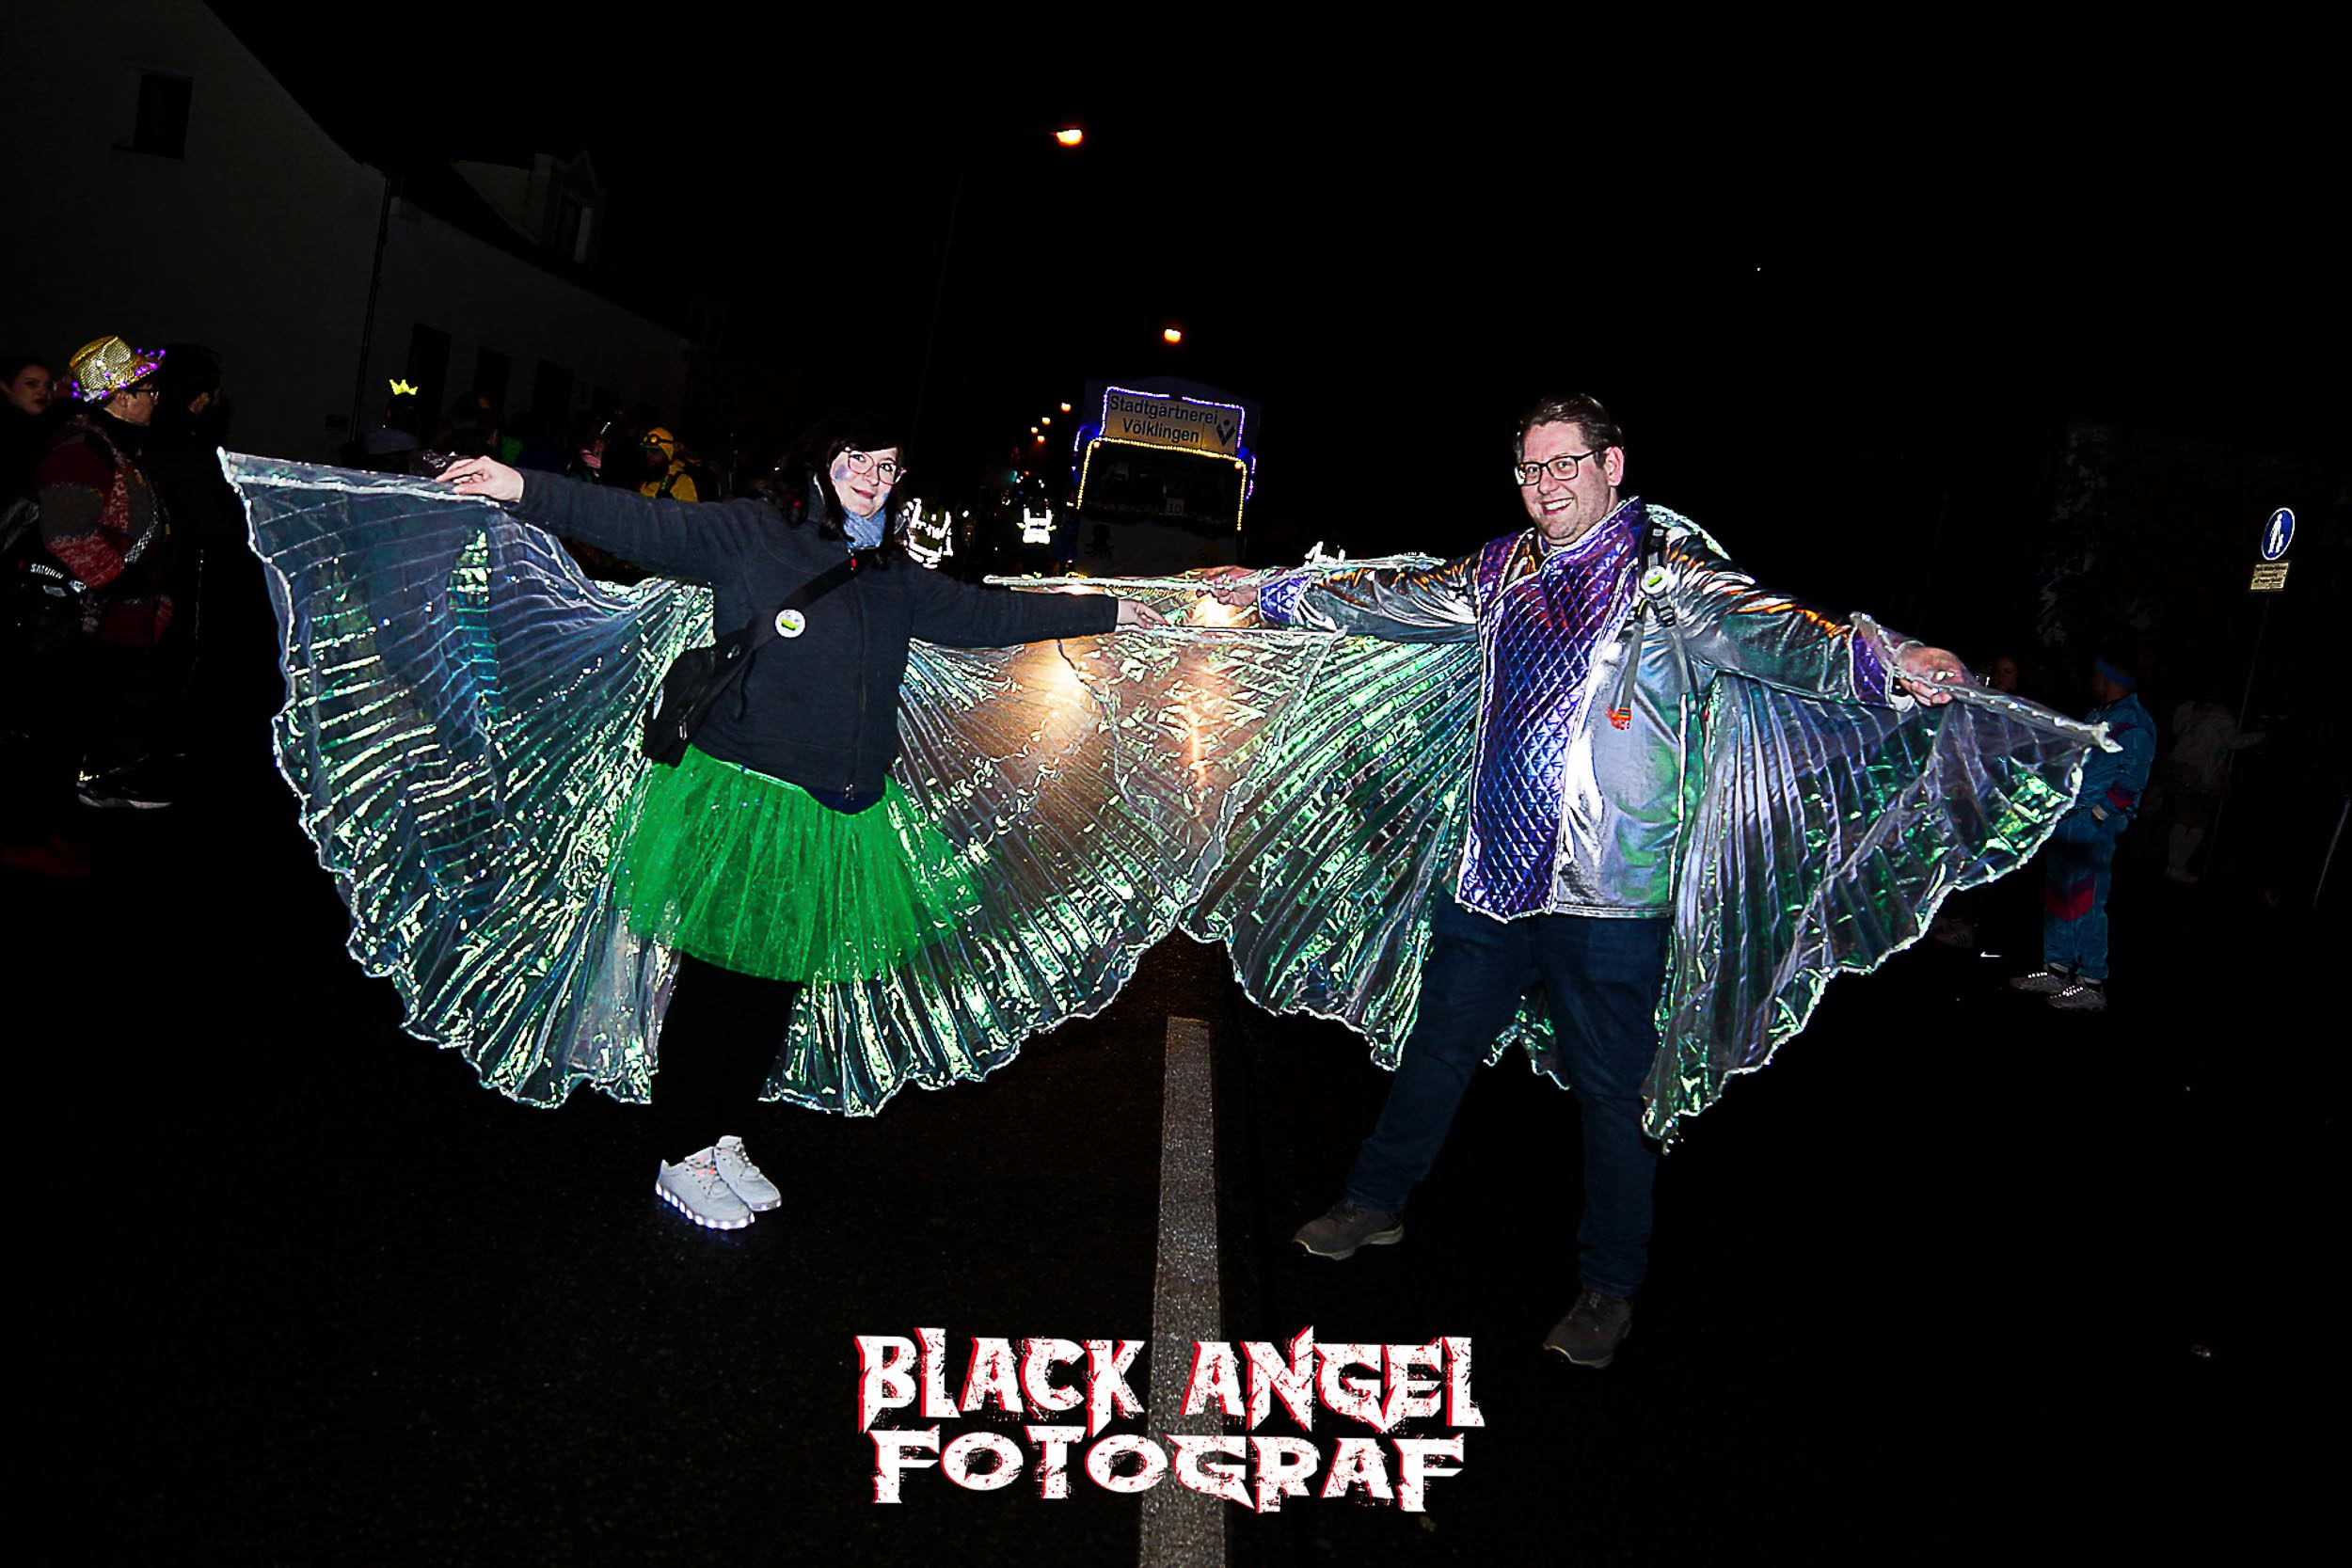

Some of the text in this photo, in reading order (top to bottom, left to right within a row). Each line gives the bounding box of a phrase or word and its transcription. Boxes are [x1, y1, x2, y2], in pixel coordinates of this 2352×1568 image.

[1109, 395, 1218, 425] Stadtgärtnerei
[1122, 418, 1200, 443] Völklingen
[30, 562, 64, 579] SATURN
